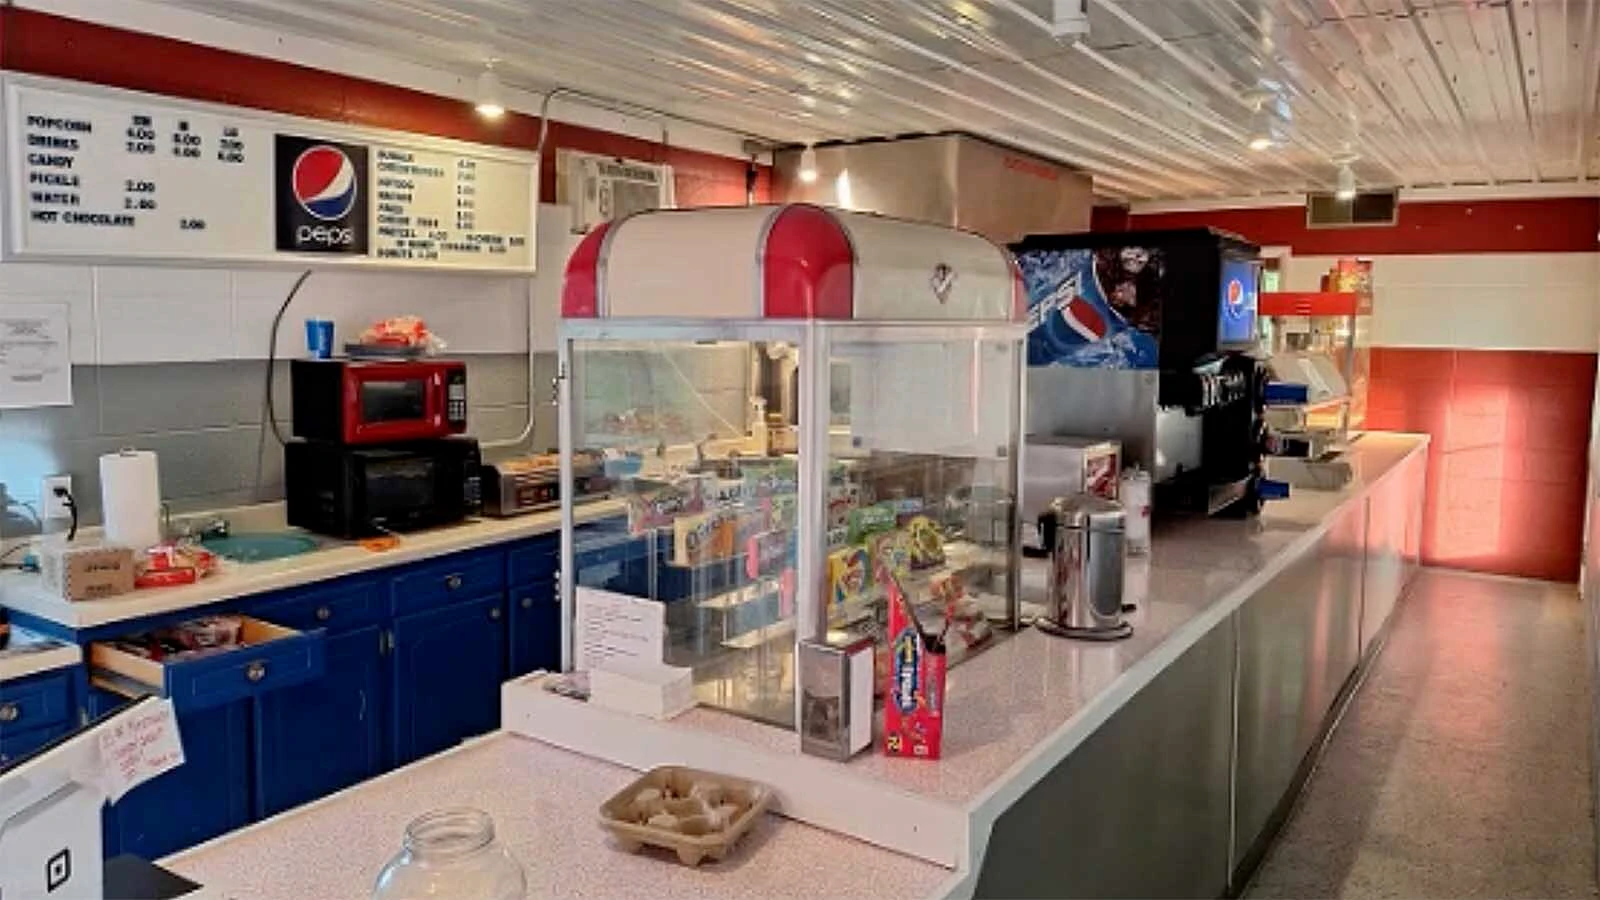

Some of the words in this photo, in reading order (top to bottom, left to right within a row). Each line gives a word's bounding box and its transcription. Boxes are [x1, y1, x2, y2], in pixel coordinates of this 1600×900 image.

[27, 115, 92, 132] POPCORN
[27, 134, 80, 150] DRINKS
[27, 153, 74, 169] CANDY
[30, 172, 80, 187] PICKLE
[31, 192, 80, 205] WATER
[30, 210, 58, 223] HOT
[62, 211, 135, 227] CHOCOLATE
